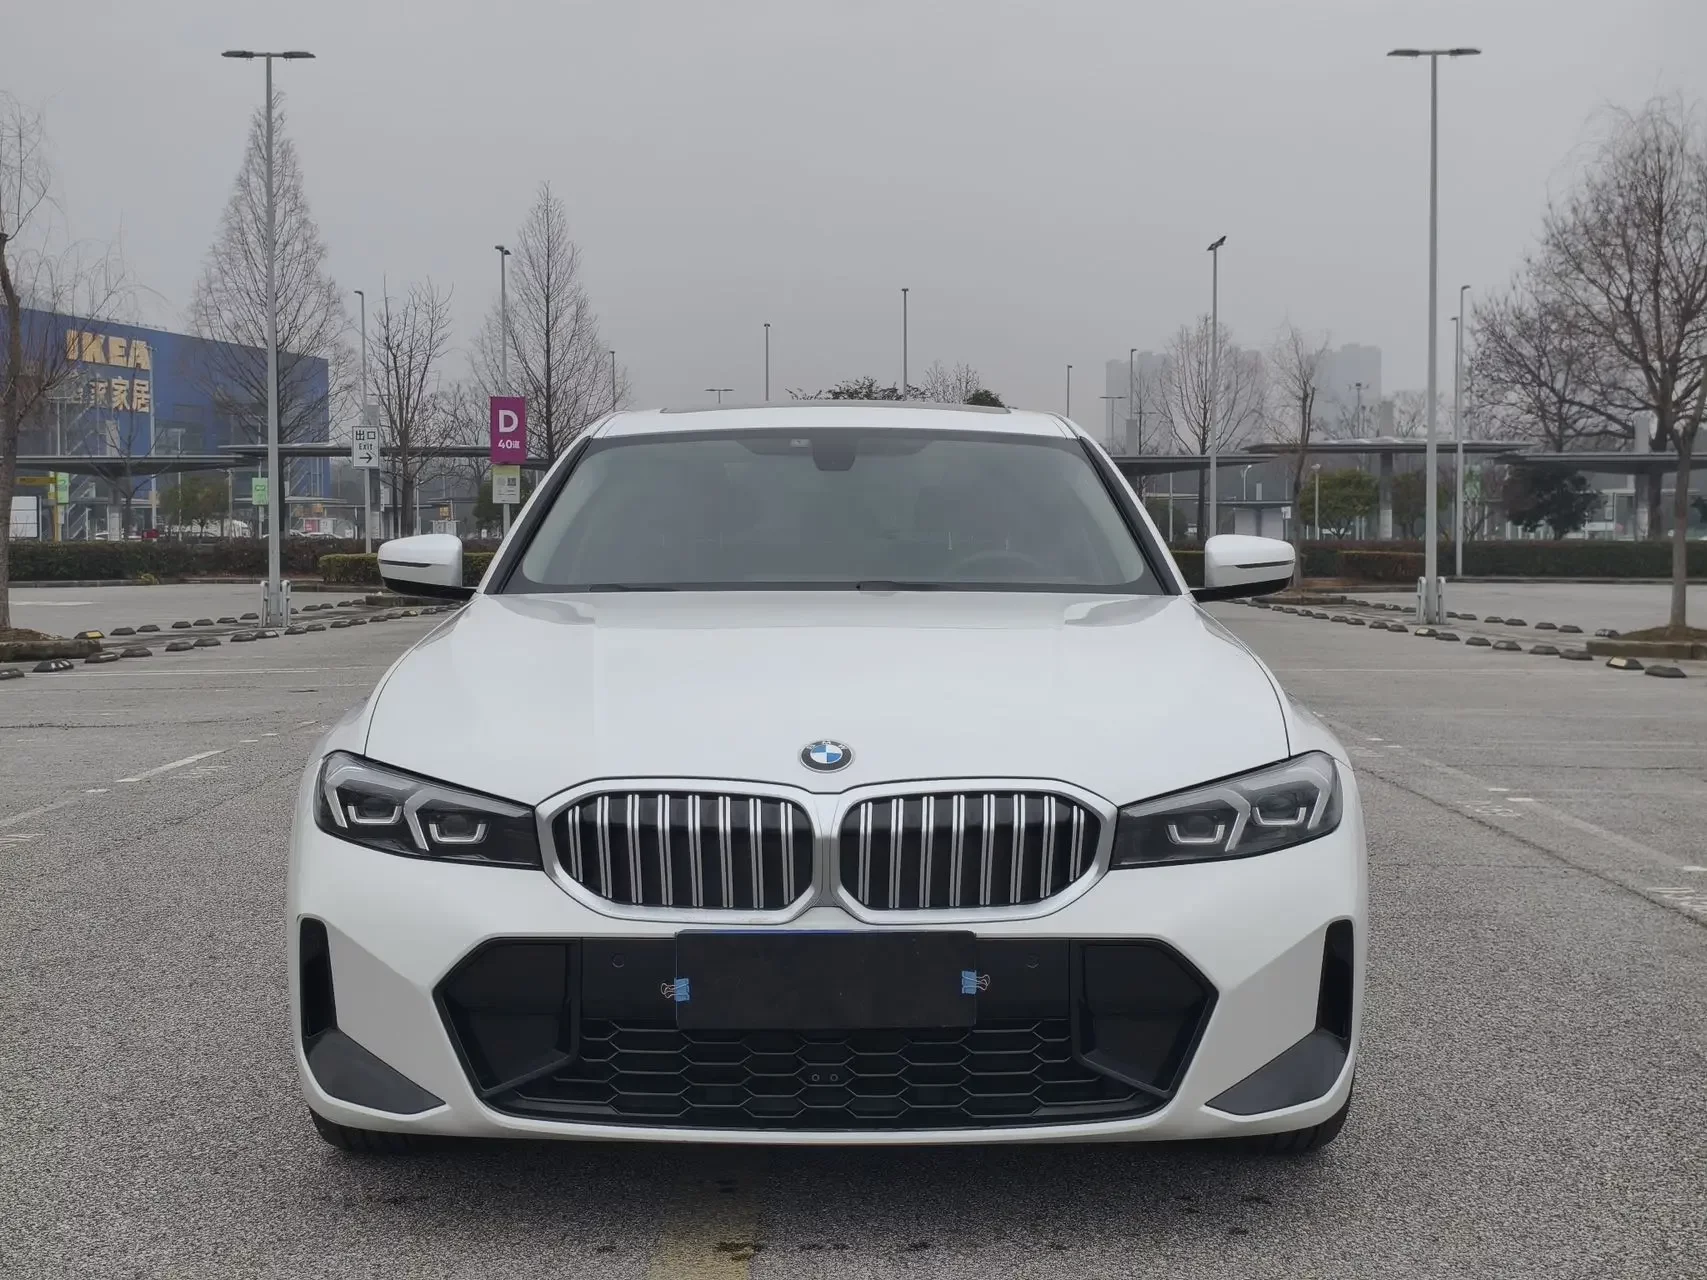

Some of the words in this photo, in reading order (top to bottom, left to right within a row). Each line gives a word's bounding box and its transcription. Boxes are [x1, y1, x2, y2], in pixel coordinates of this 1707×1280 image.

[65, 329, 151, 370] IKEA
[499, 410, 518, 432] D
[356, 430, 376, 440] 出口
[359, 443, 373, 451] Exit
